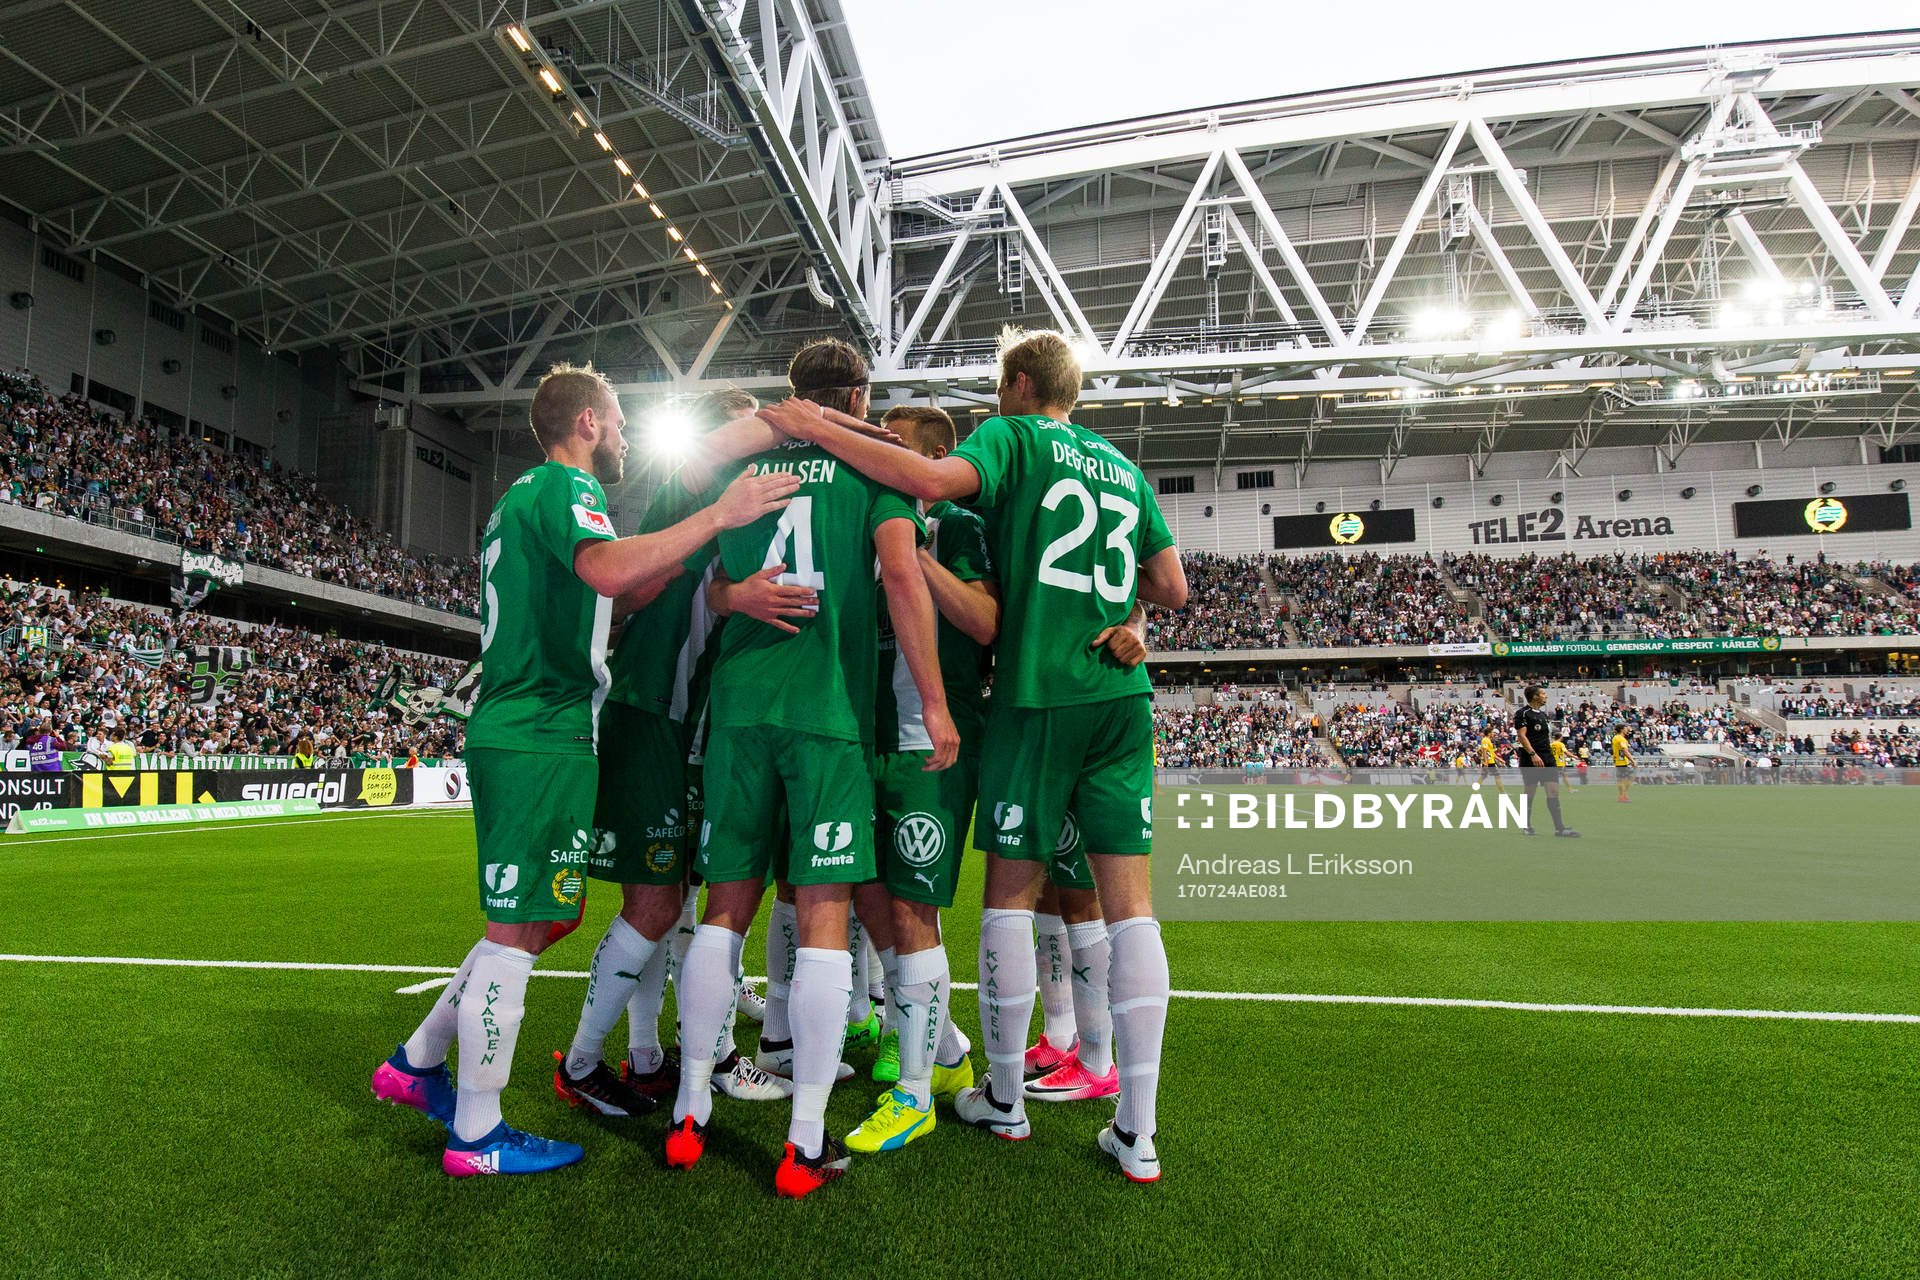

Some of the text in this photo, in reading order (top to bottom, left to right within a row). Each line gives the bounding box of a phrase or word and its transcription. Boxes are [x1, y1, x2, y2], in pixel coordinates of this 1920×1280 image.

[1038, 478, 1139, 602] 23
[1468, 507, 1674, 544] TELE2 Arena
[762, 495, 825, 612] 4
[1512, 645, 1564, 653] HAMMARBY
[1566, 644, 1602, 652] FOTBOLL
[1606, 643, 1664, 651] GEMENSKAP
[1672, 642, 1714, 650] RESPEKT
[32, 742, 43, 751] 46
[242, 773, 347, 805] swedol
[811, 853, 855, 867] fronta
[486, 895, 518, 908] fronta
[587, 932, 611, 1007] KVARNEN
[986, 949, 1000, 1042] KVARNEN
[481, 981, 501, 1065] KVARNEN
